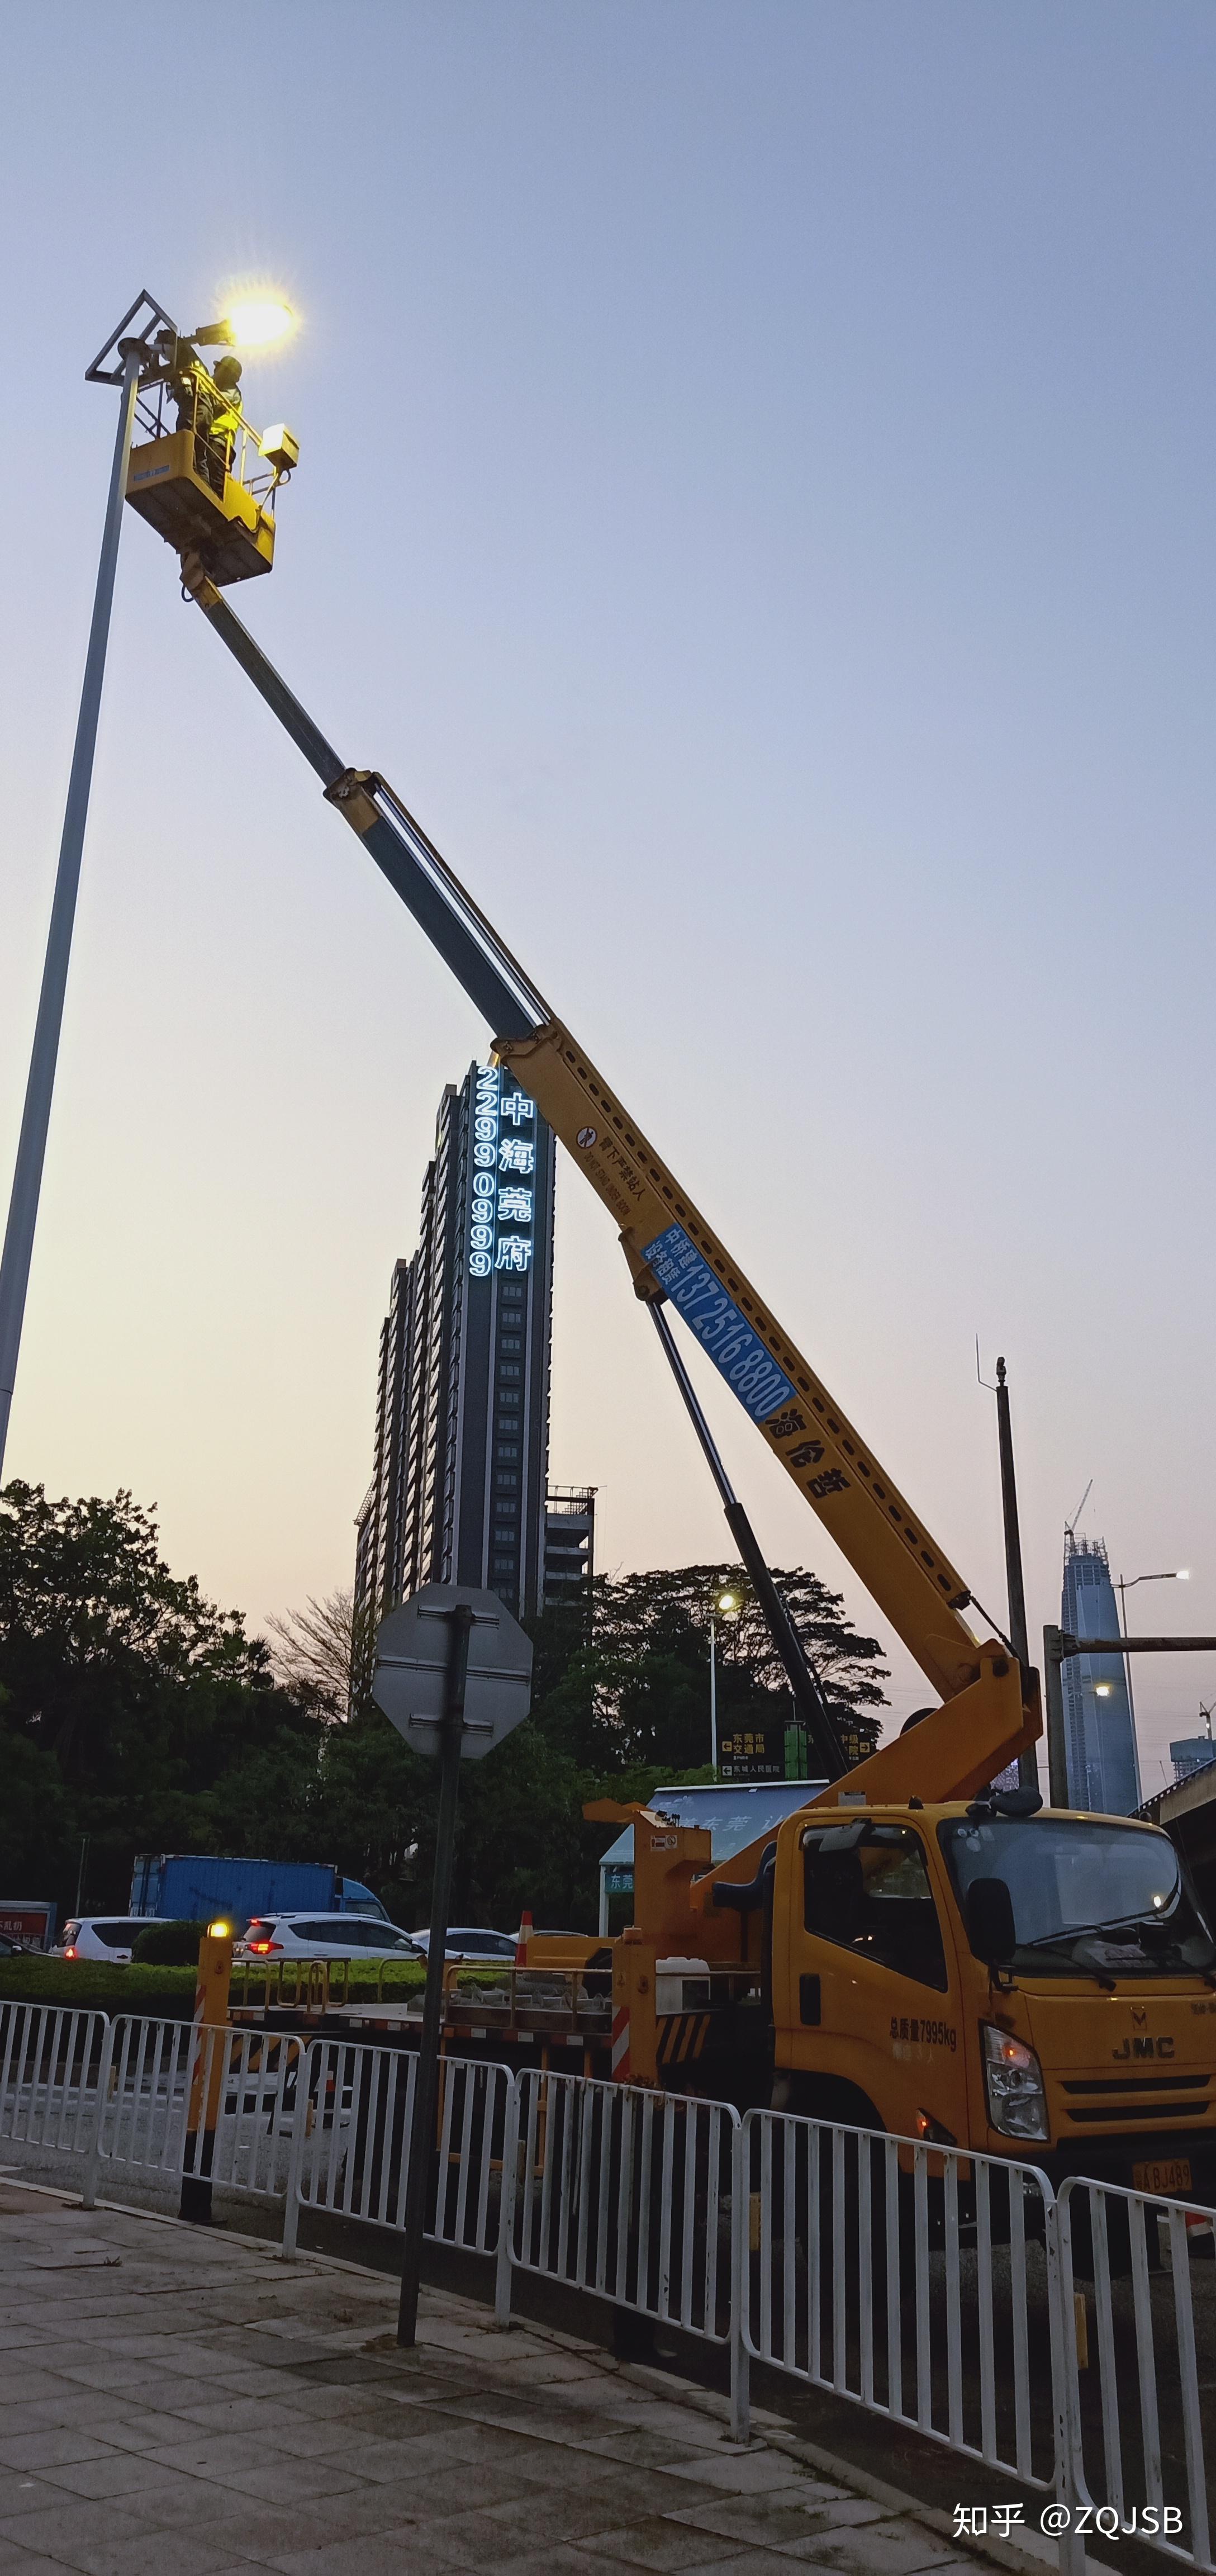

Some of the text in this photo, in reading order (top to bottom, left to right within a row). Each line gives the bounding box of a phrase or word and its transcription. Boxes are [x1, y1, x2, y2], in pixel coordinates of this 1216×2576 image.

[469, 1066, 499, 1277] 22990999
[495, 1092, 535, 1272] 中海莞府
[599, 1136, 646, 1201] 臂下严禁站人
[645, 1240, 681, 1285] 设备租赁
[664, 1228, 698, 1270] 中桥建
[765, 1408, 851, 1499] 海伦哲
[733, 1733, 764, 1744] 东莞市
[733, 1744, 765, 1754] 交通局
[733, 1764, 780, 1773] 东城人民医院
[611, 1874, 634, 1890] 东莞
[890, 2016, 957, 2053] 总质量7995kg
[1112, 2037, 1175, 2059] JMC
